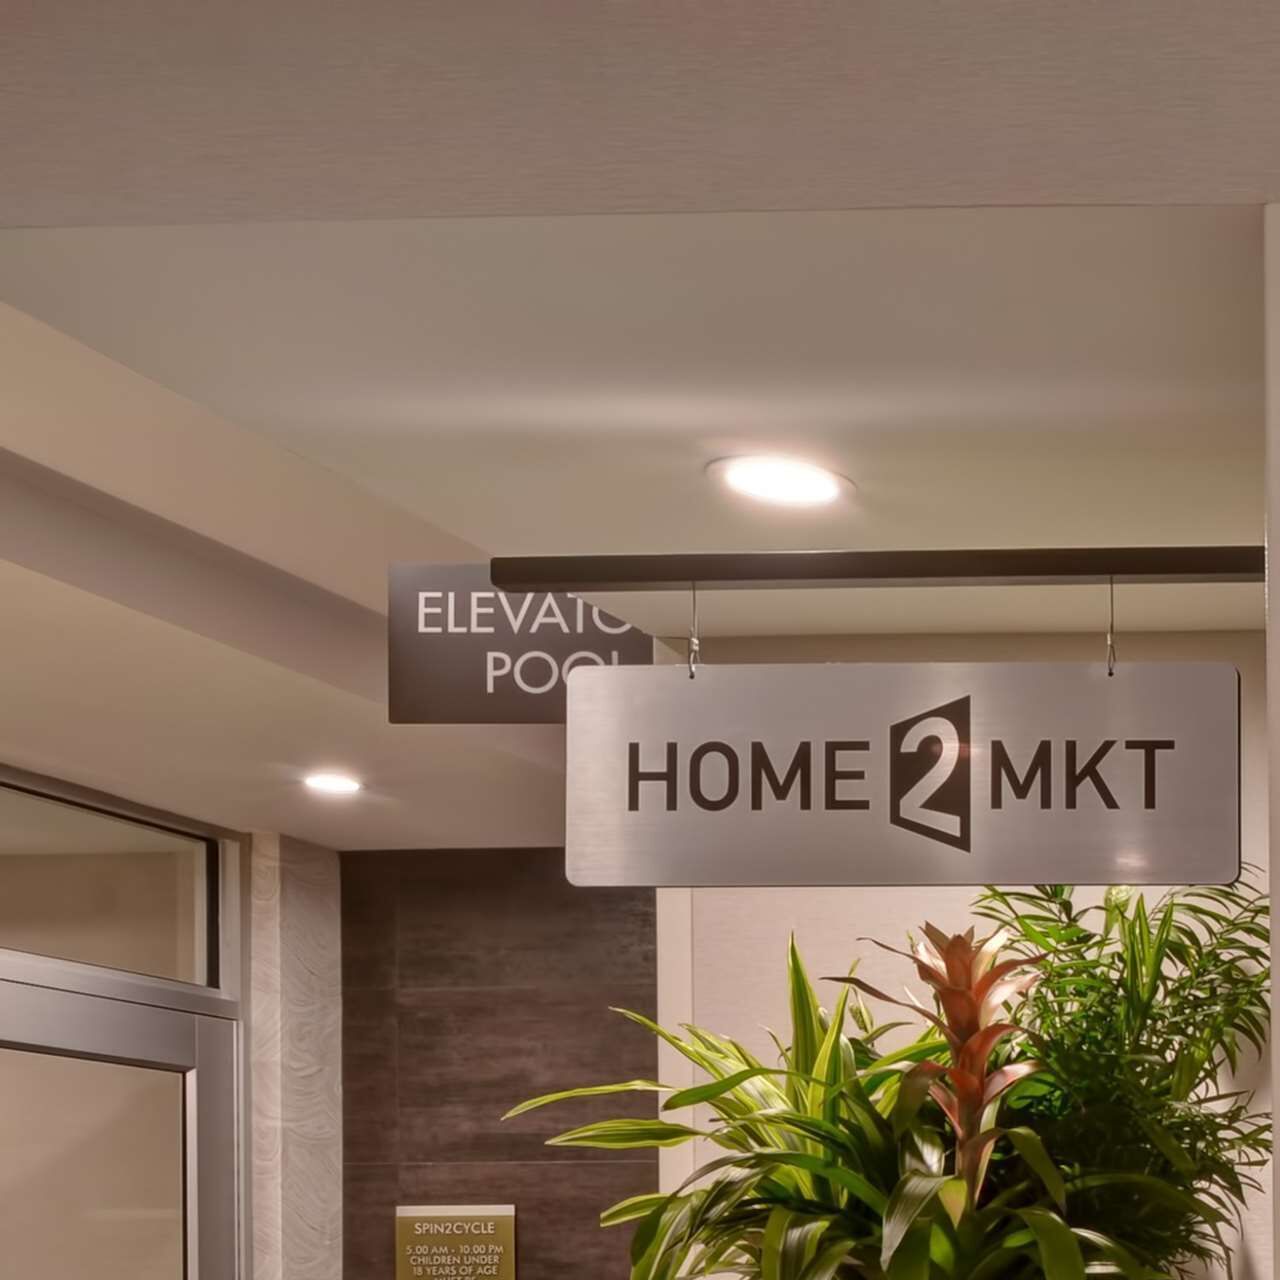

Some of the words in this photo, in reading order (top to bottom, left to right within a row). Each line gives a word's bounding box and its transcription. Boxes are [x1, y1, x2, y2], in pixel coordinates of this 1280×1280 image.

[627, 740, 871, 812] HOME
[990, 739, 1176, 811] MKT
[414, 1222, 496, 1235] SPIN2CYCLE
[431, 1245, 449, 1254] AM
[488, 1244, 504, 1254] PM
[410, 1255, 461, 1265] CHILDREN
[463, 1255, 500, 1265] UNDER
[425, 1266, 457, 1276] YEARS
[459, 1265, 474, 1275] OF
[477, 1265, 498, 1275] AGE
